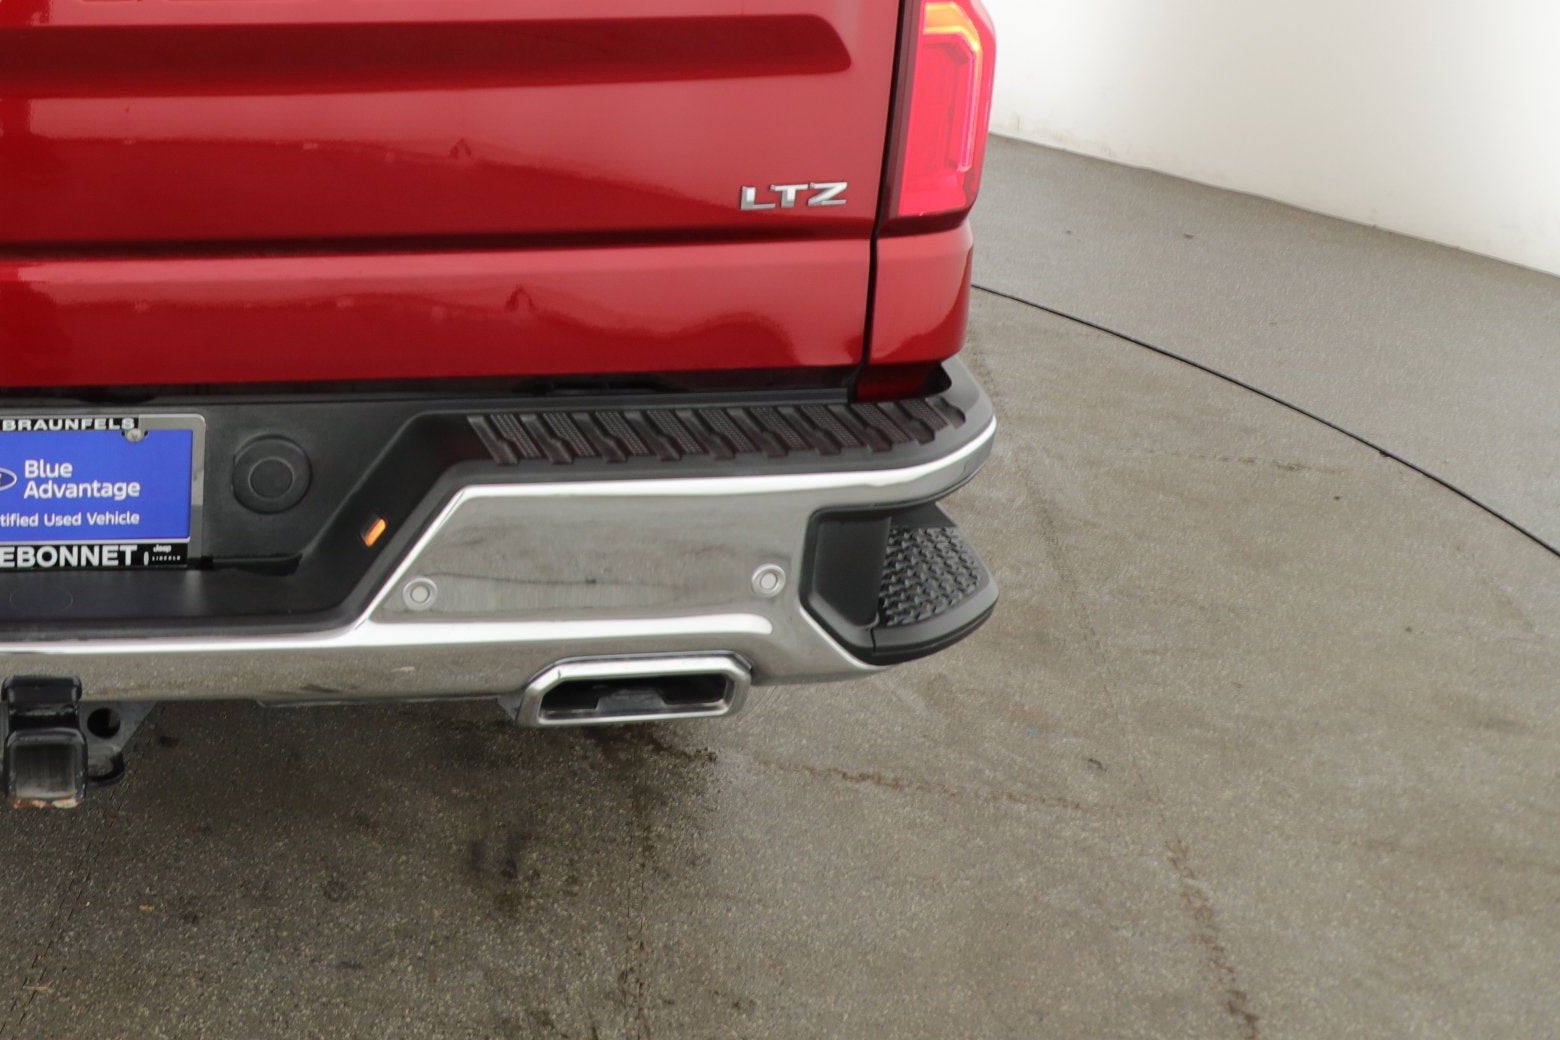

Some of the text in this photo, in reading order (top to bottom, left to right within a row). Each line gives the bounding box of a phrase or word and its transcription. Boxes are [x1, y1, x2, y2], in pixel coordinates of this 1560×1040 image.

[740, 182, 848, 210] LTZ
[3, 417, 136, 431] BRAUNFELS
[24, 459, 73, 479] Blue
[23, 479, 140, 501] Advantage
[44, 513, 82, 527] Used
[87, 511, 140, 526] Vehicle
